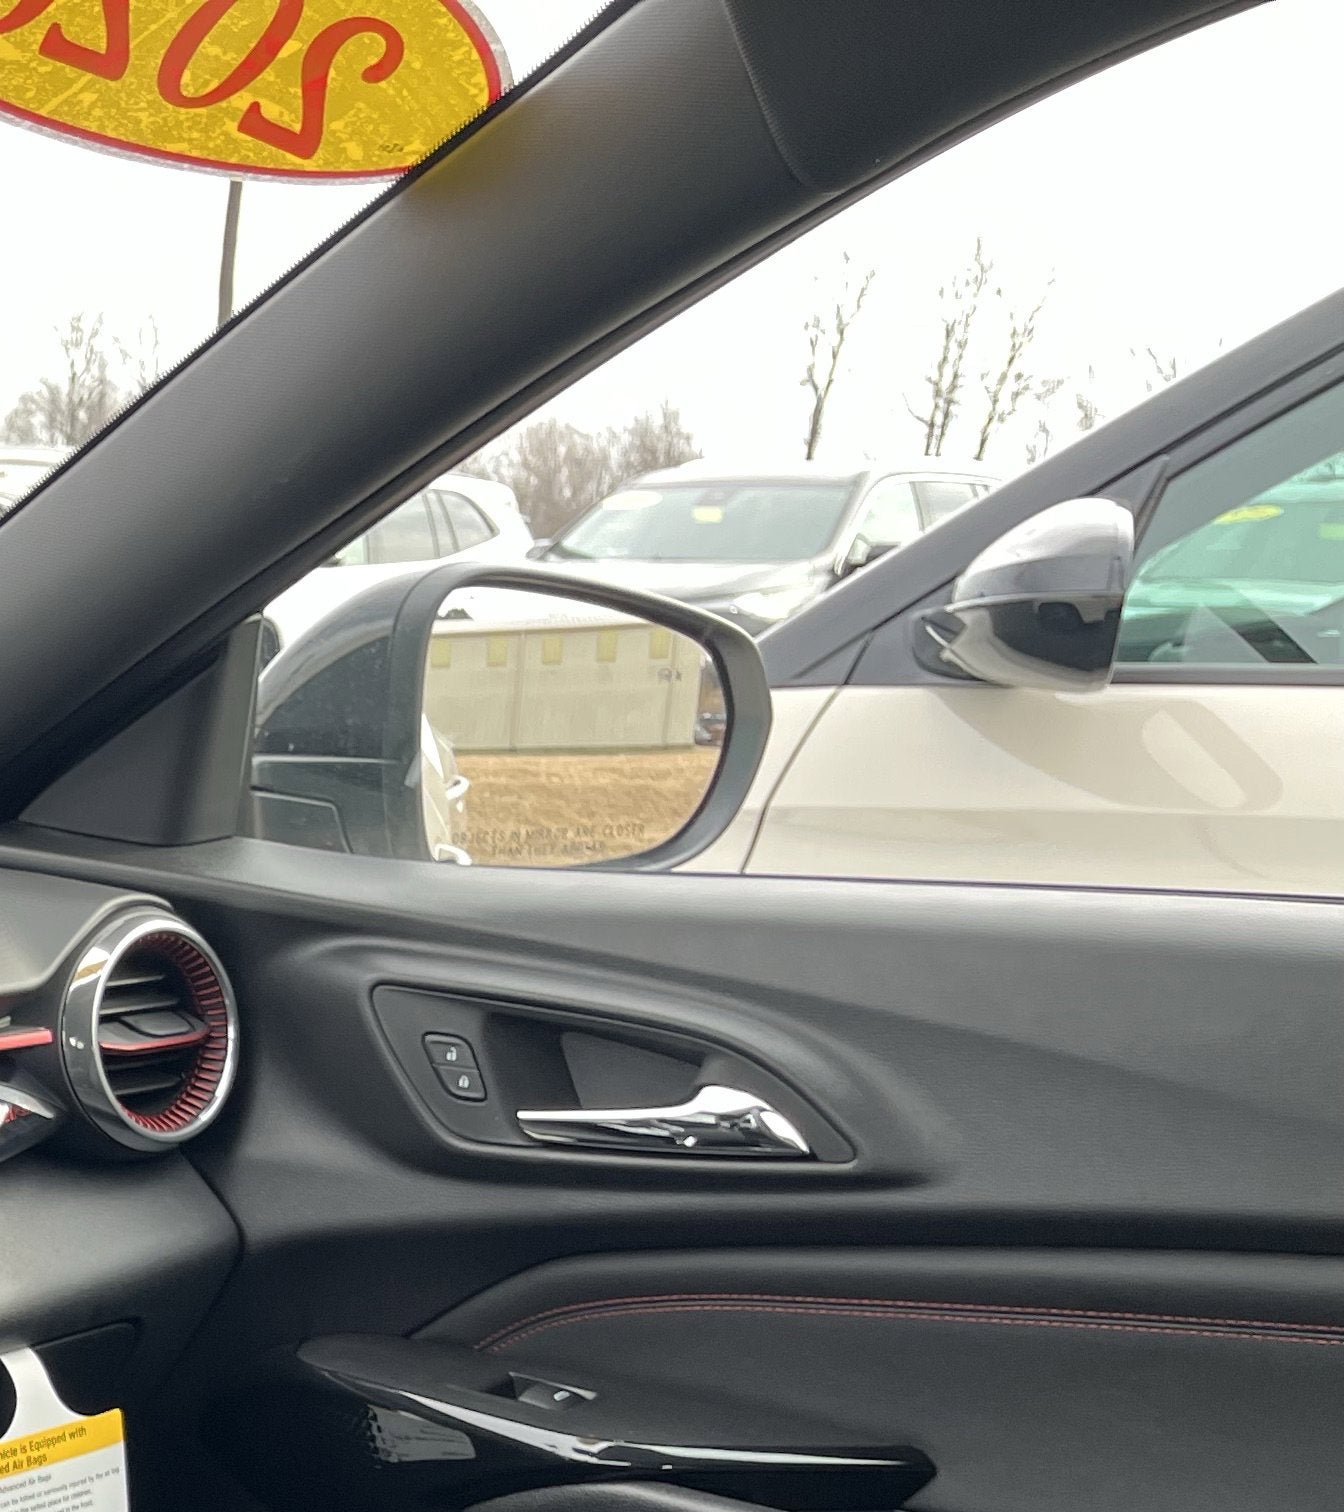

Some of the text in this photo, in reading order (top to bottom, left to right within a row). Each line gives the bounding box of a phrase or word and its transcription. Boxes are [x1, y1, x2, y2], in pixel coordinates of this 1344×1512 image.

[20, 1443, 27, 1454] is
[29, 1431, 67, 1452] Equipped
[68, 1425, 87, 1440] with
[12, 1459, 24, 1472] Air
[26, 1453, 48, 1467] Bags
